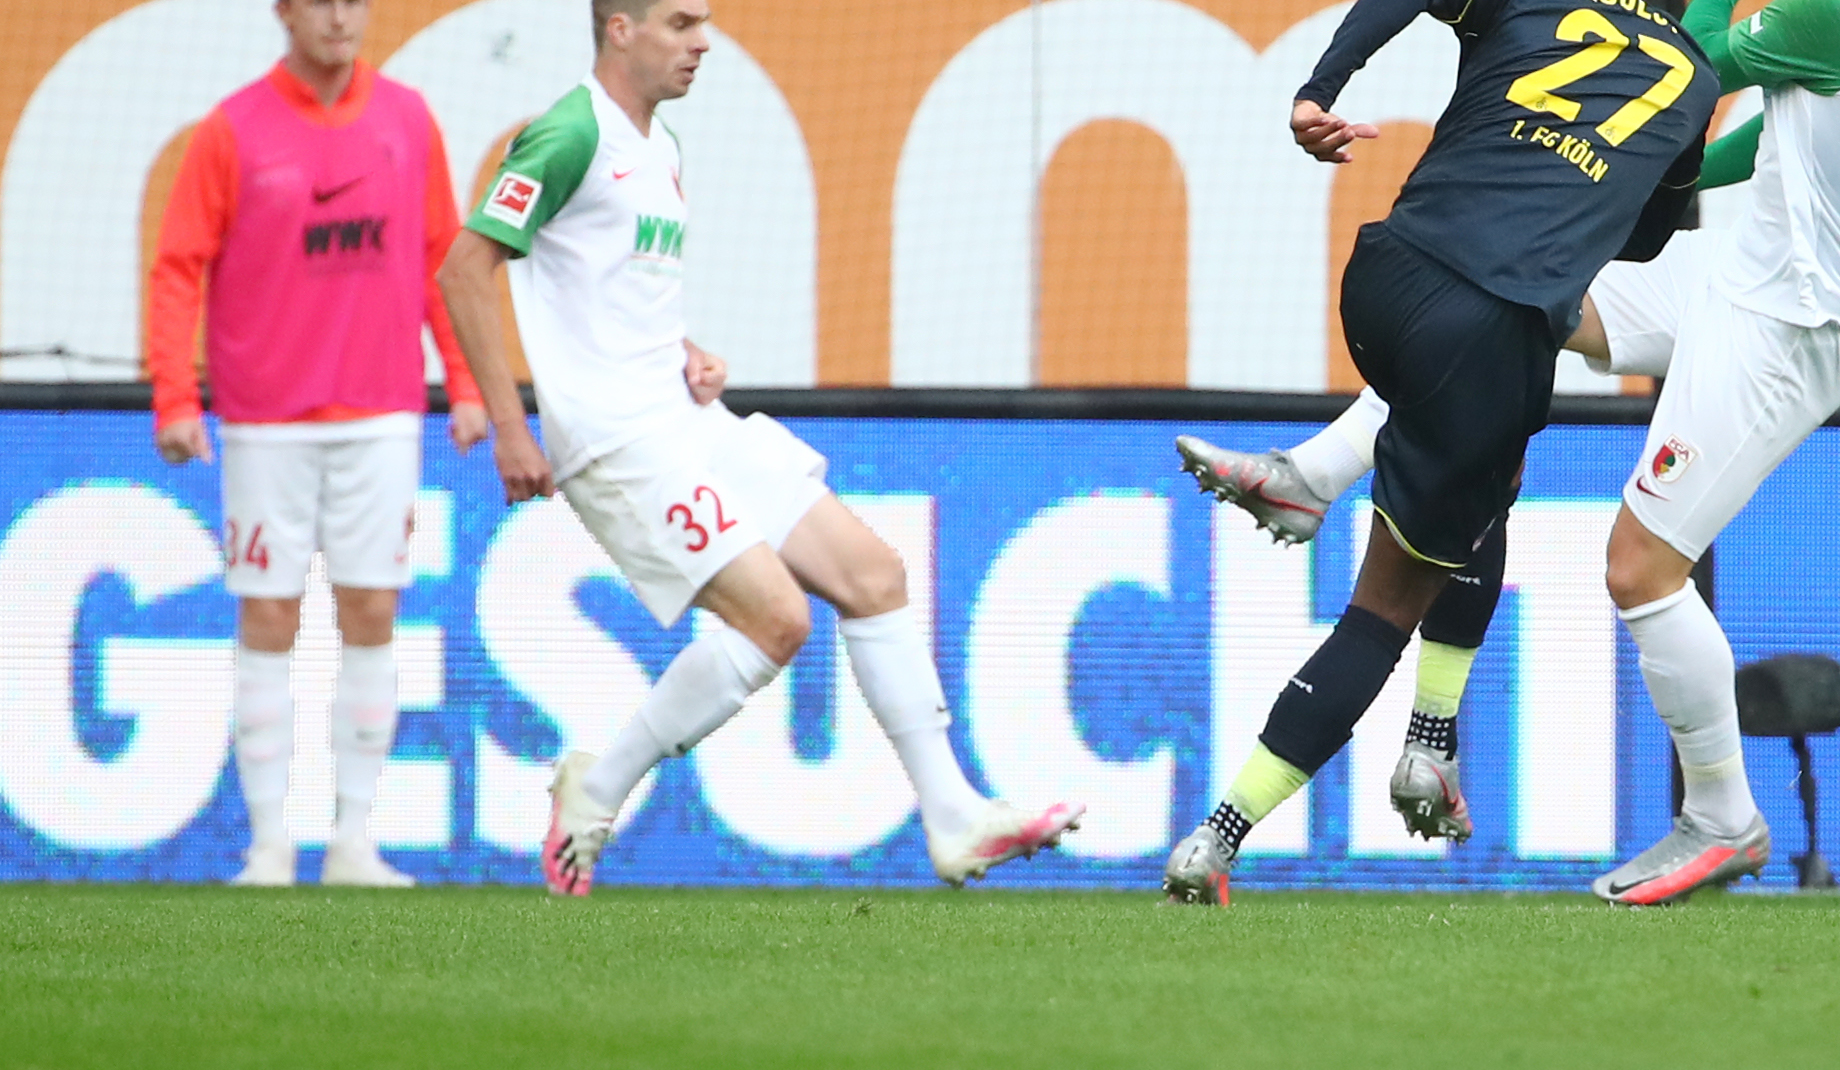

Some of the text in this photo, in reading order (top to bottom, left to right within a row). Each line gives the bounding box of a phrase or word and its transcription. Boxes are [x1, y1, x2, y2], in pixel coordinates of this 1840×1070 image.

[1505, 8, 1696, 148] 27
[1509, 119, 1610, 183] 1. FC KÖLN
[303, 216, 388, 255] WWK
[665, 484, 739, 553] 32
